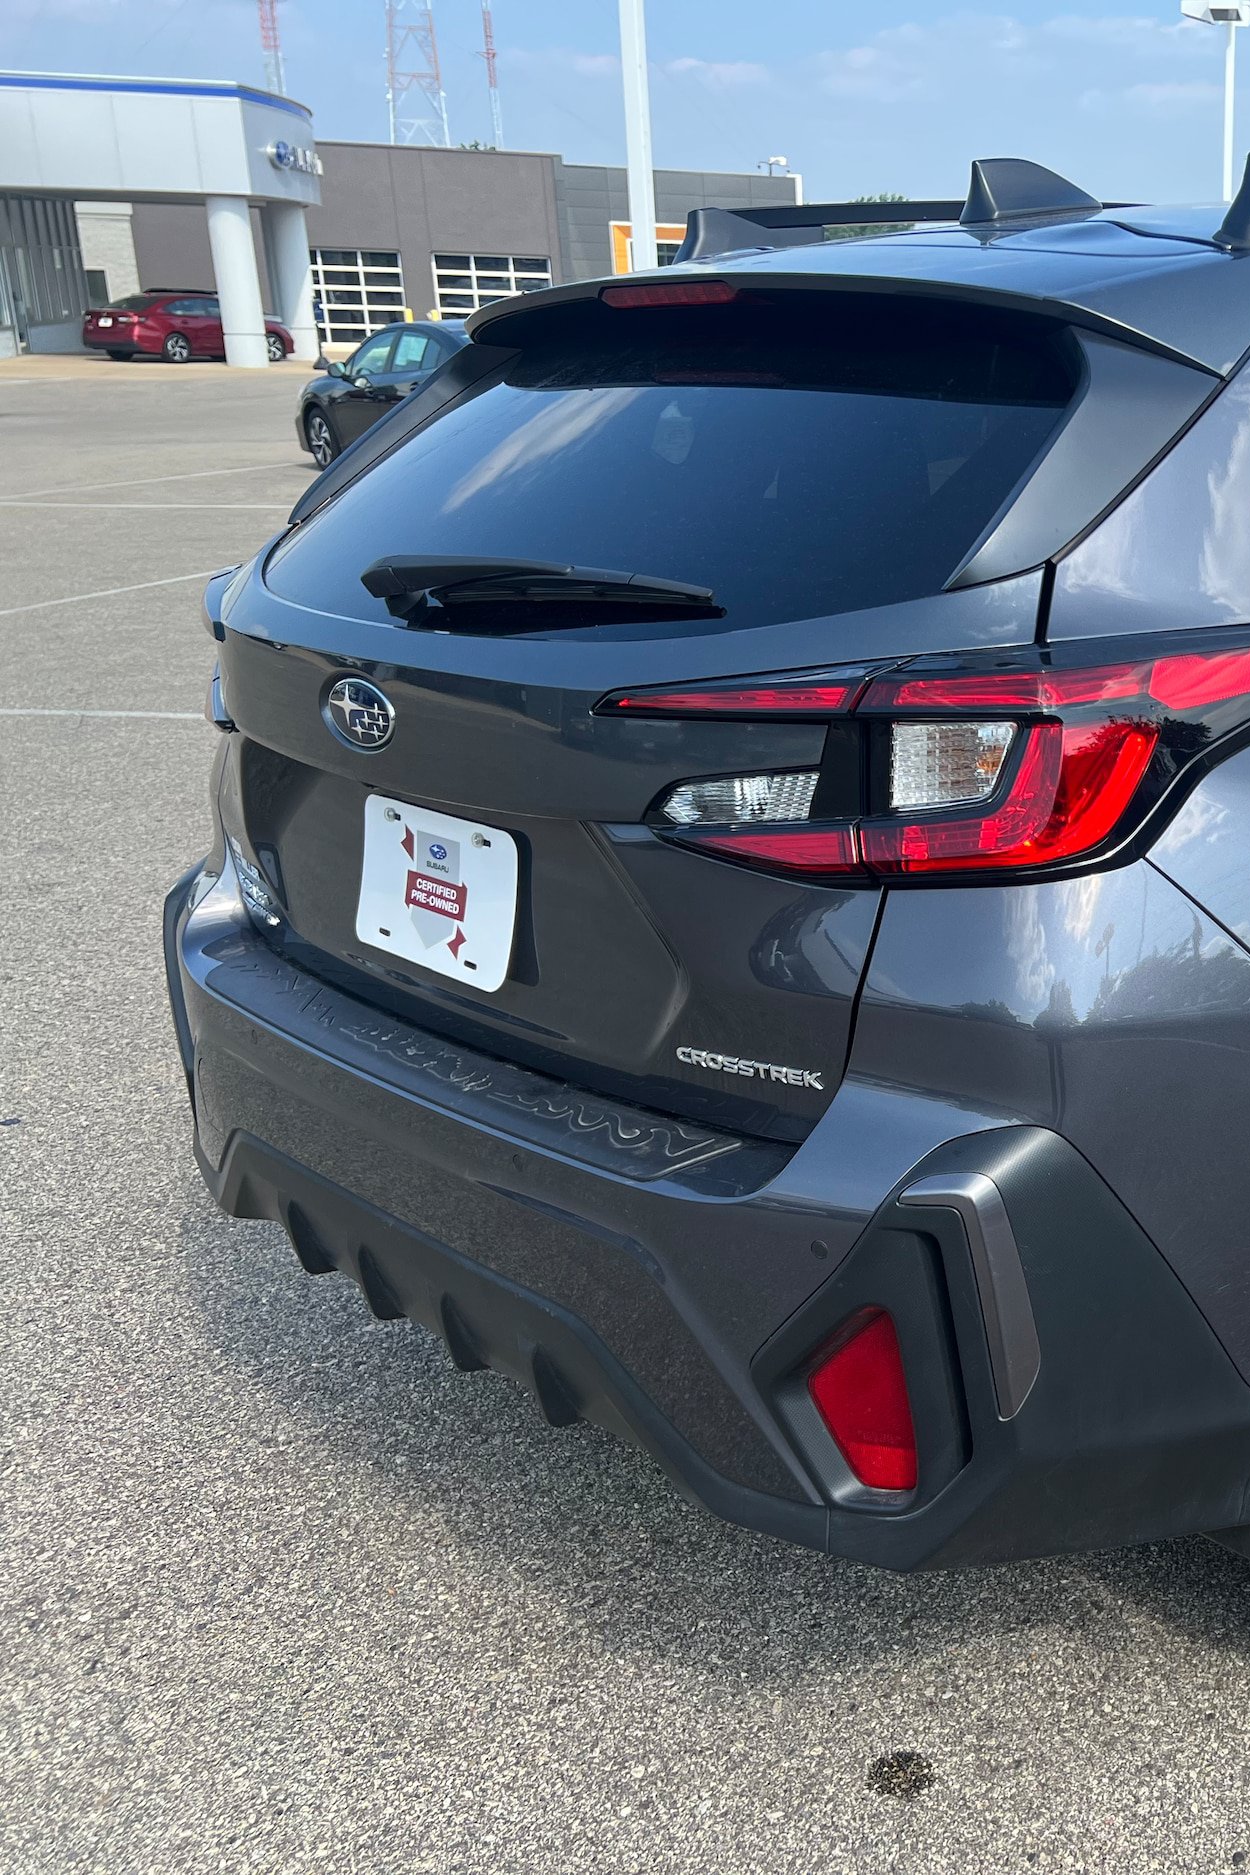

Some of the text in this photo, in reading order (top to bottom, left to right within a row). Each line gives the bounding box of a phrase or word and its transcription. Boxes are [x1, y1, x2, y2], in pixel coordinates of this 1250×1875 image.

[426, 861, 449, 873] SUBARU
[416, 878, 457, 900] CERTIFIED
[411, 891, 459, 914] PRE-OWNED
[675, 1046, 824, 1090] CROSSTREK
